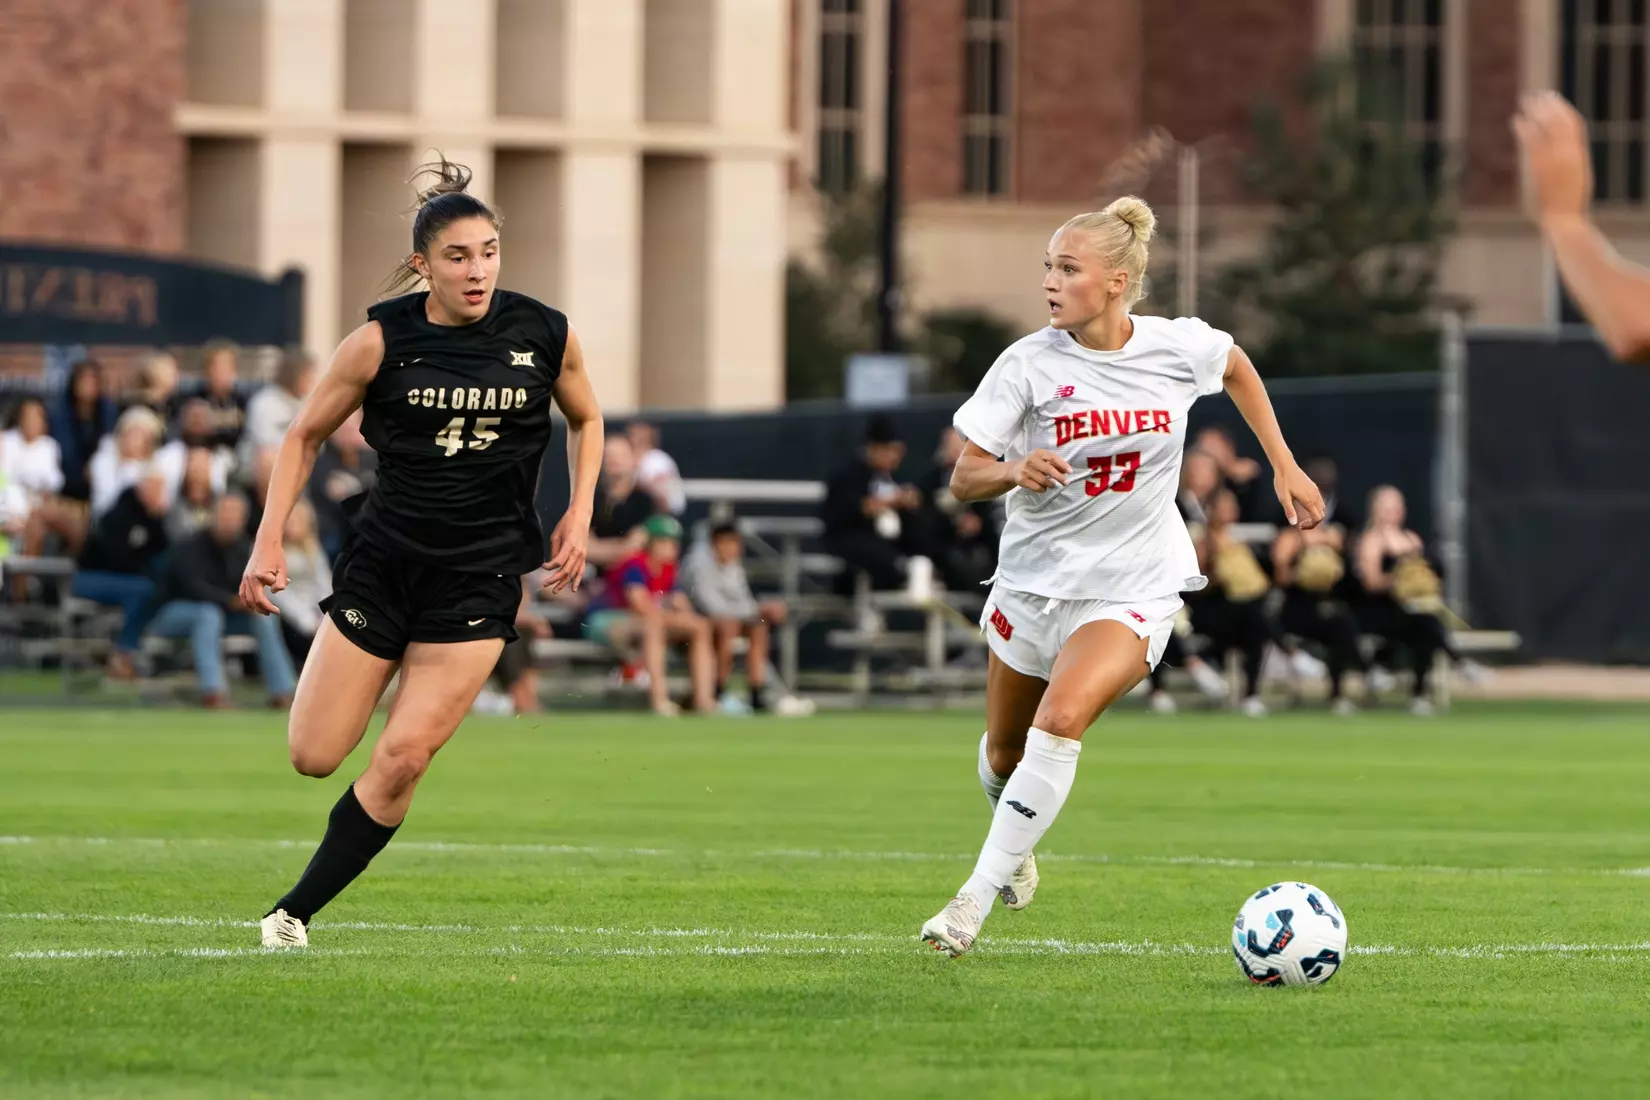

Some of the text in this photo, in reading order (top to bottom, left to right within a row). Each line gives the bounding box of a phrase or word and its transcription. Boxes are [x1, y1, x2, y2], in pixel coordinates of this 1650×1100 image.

[407, 387, 528, 410] COLORADO
[435, 417, 502, 457] 45
[1054, 409, 1171, 447] DENVER
[1084, 451, 1141, 497] 33
